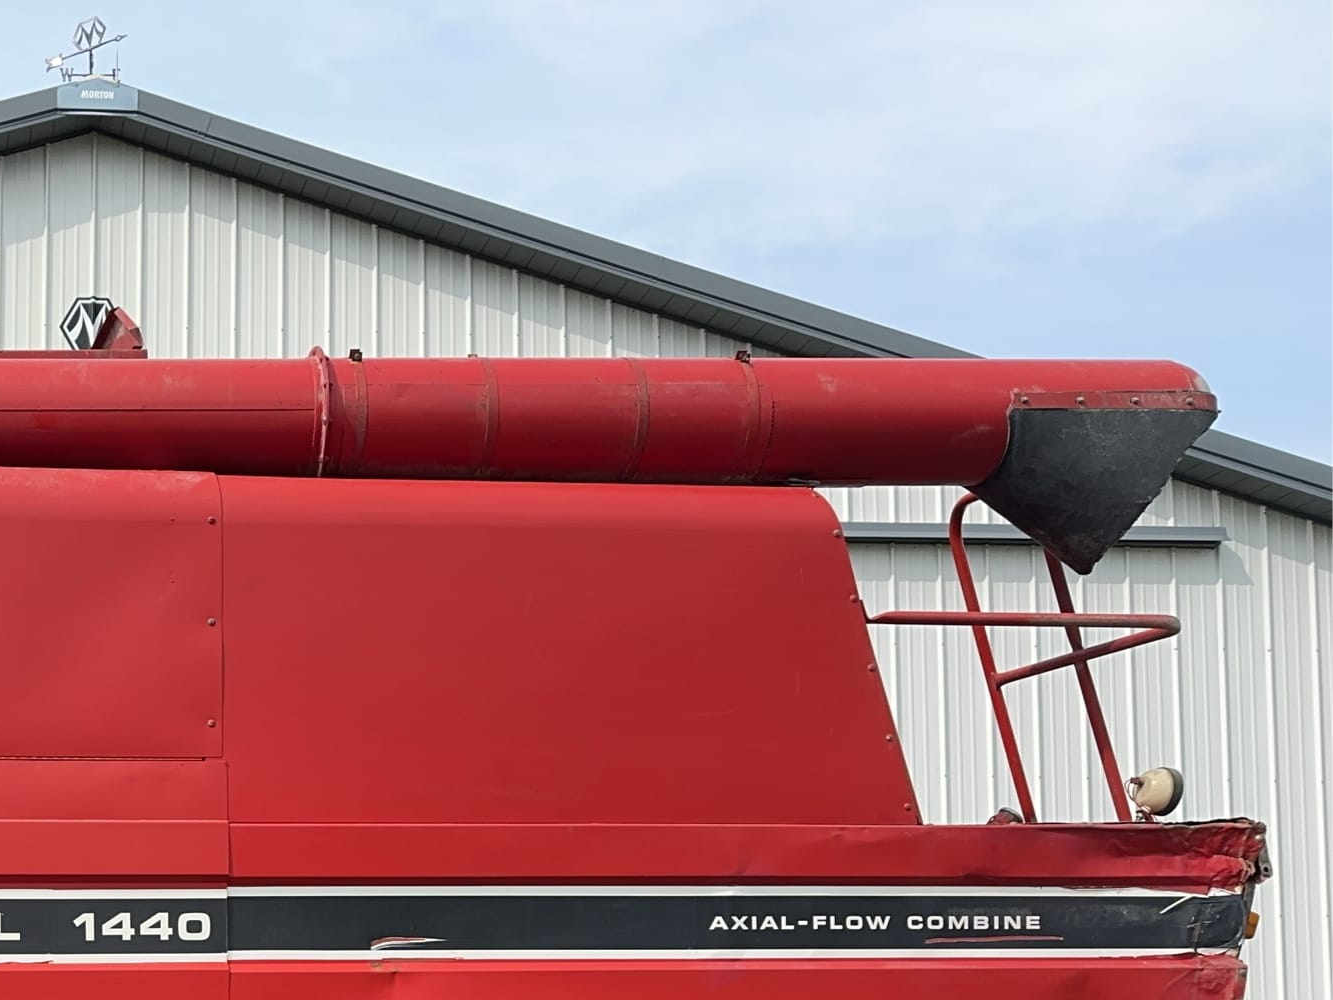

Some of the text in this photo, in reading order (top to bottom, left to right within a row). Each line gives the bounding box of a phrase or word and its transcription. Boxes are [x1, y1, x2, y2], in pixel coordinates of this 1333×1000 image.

[80, 90, 114, 99] MORTON
[73, 912, 212, 941] 1440
[708, 914, 1042, 931] AXIAL-FLOW COMBINE
